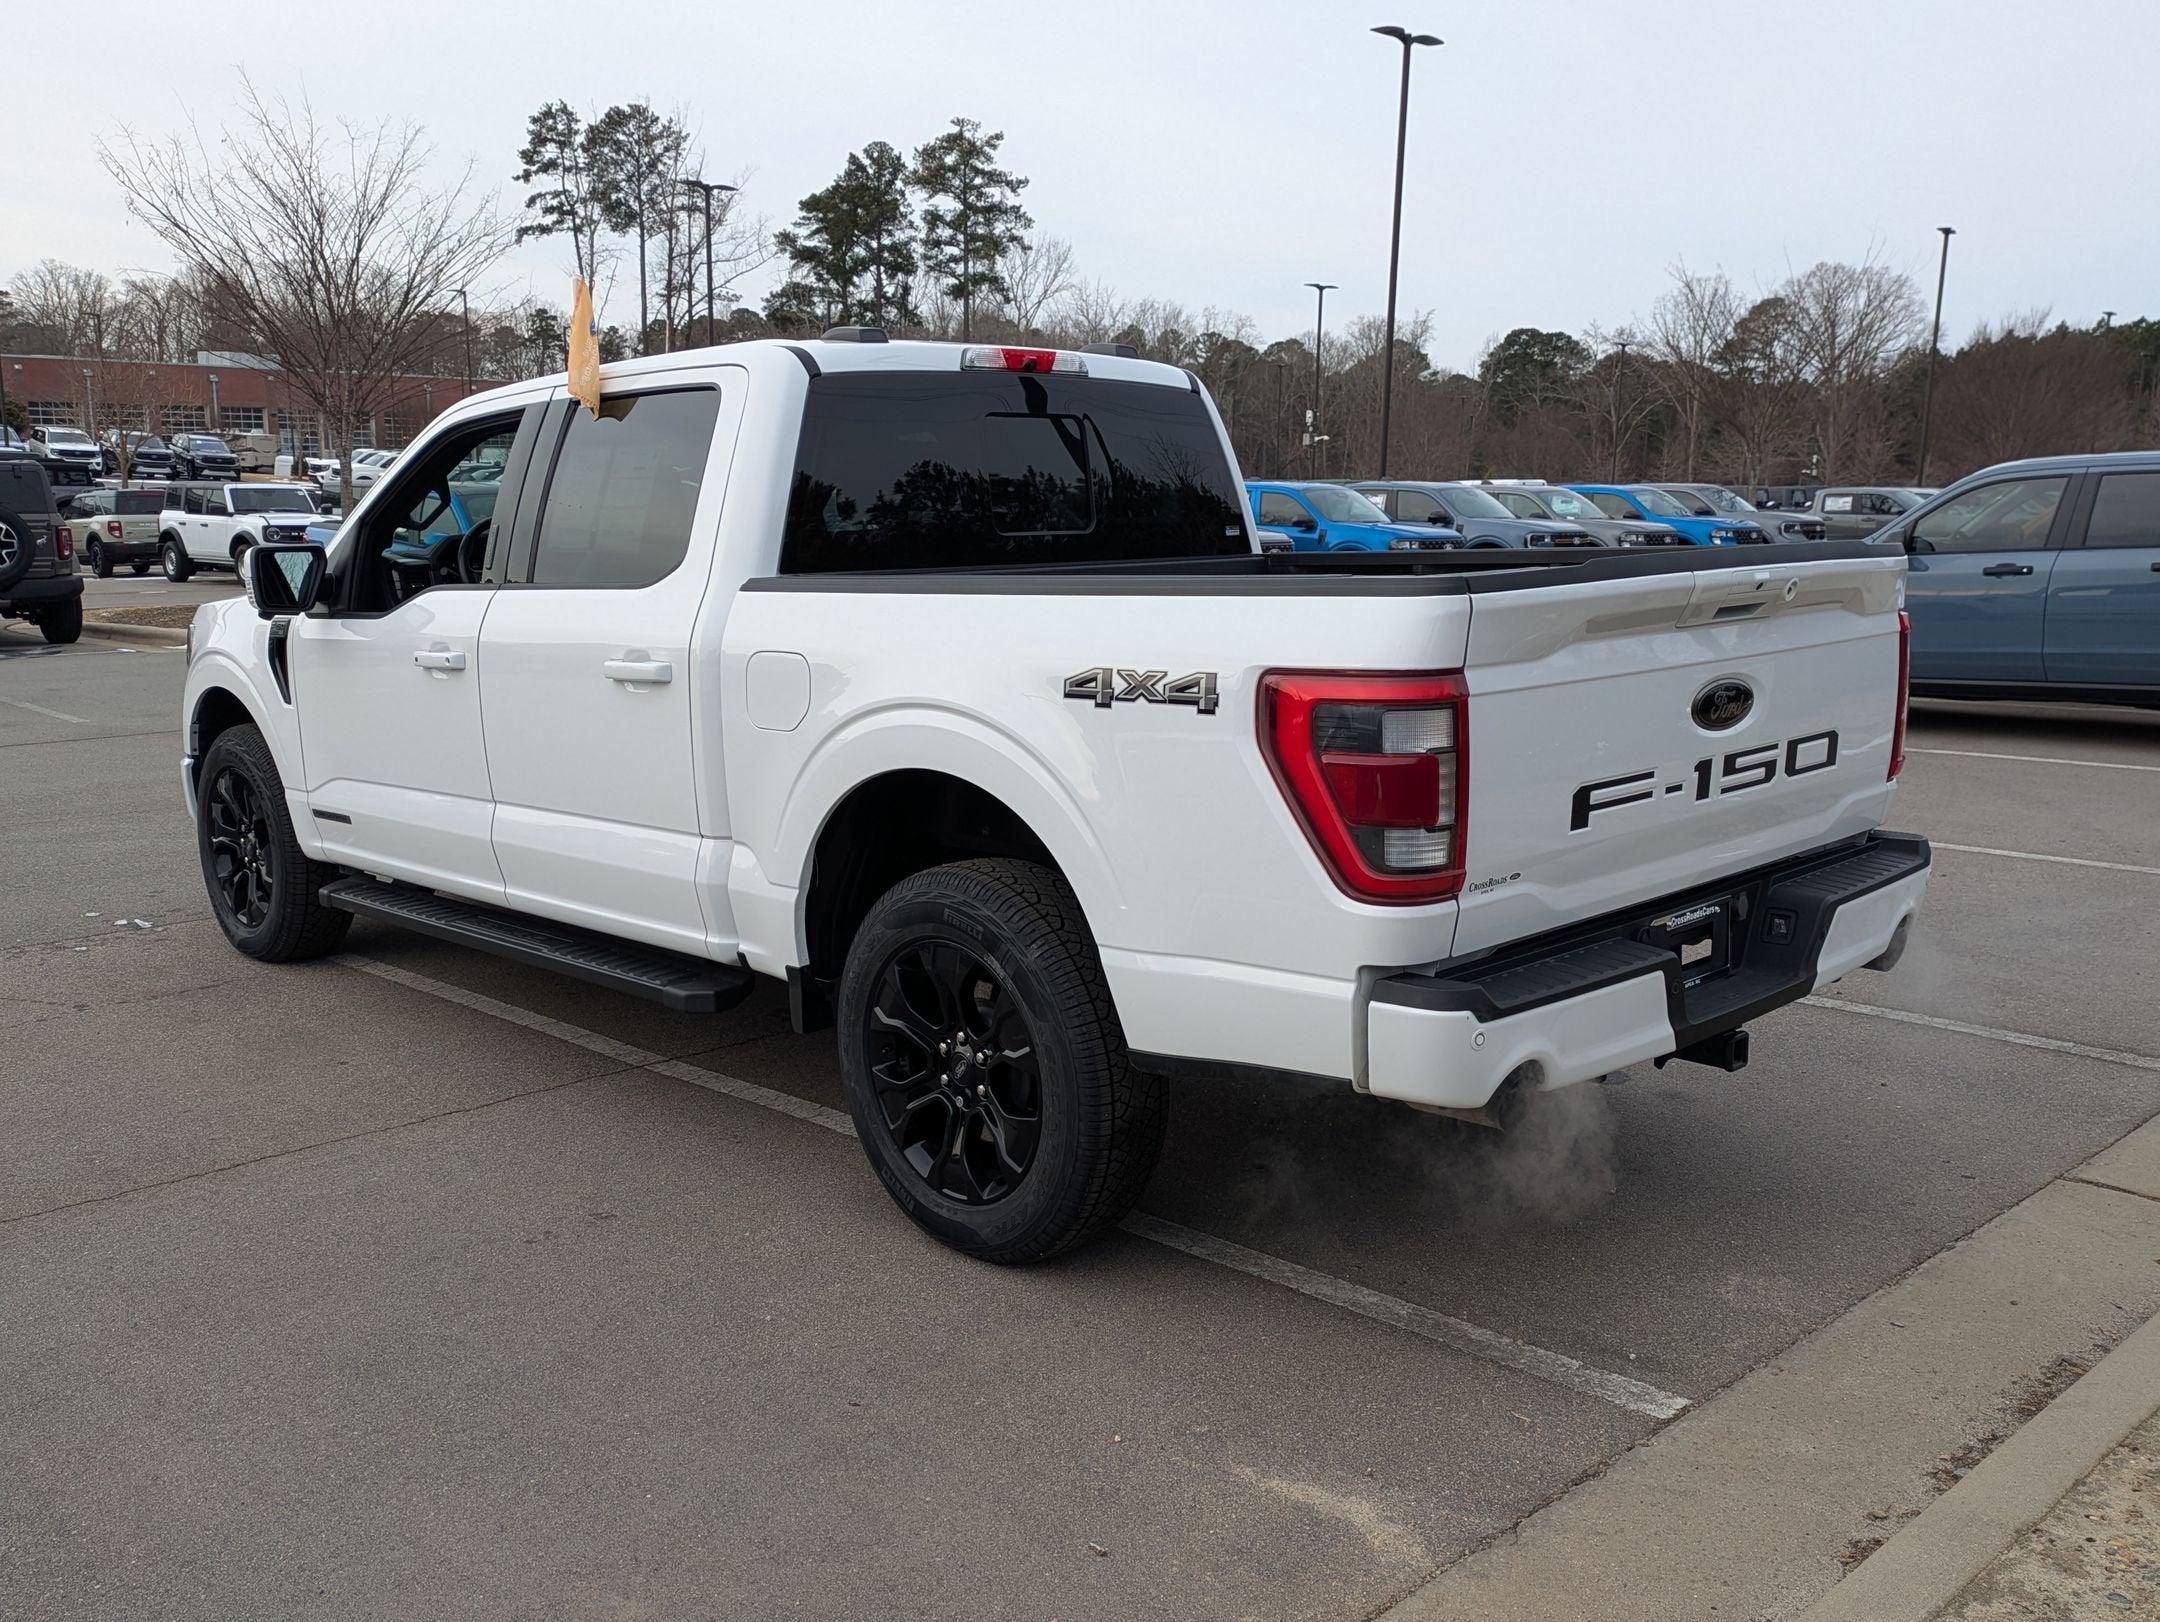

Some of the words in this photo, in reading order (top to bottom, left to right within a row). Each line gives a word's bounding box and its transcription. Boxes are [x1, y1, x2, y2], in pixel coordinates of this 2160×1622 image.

[1064, 667, 1219, 715] 4X4
[1711, 689, 1752, 720] Ford
[1570, 730, 1838, 832] F-150
[944, 907, 983, 940] PIRELLI
